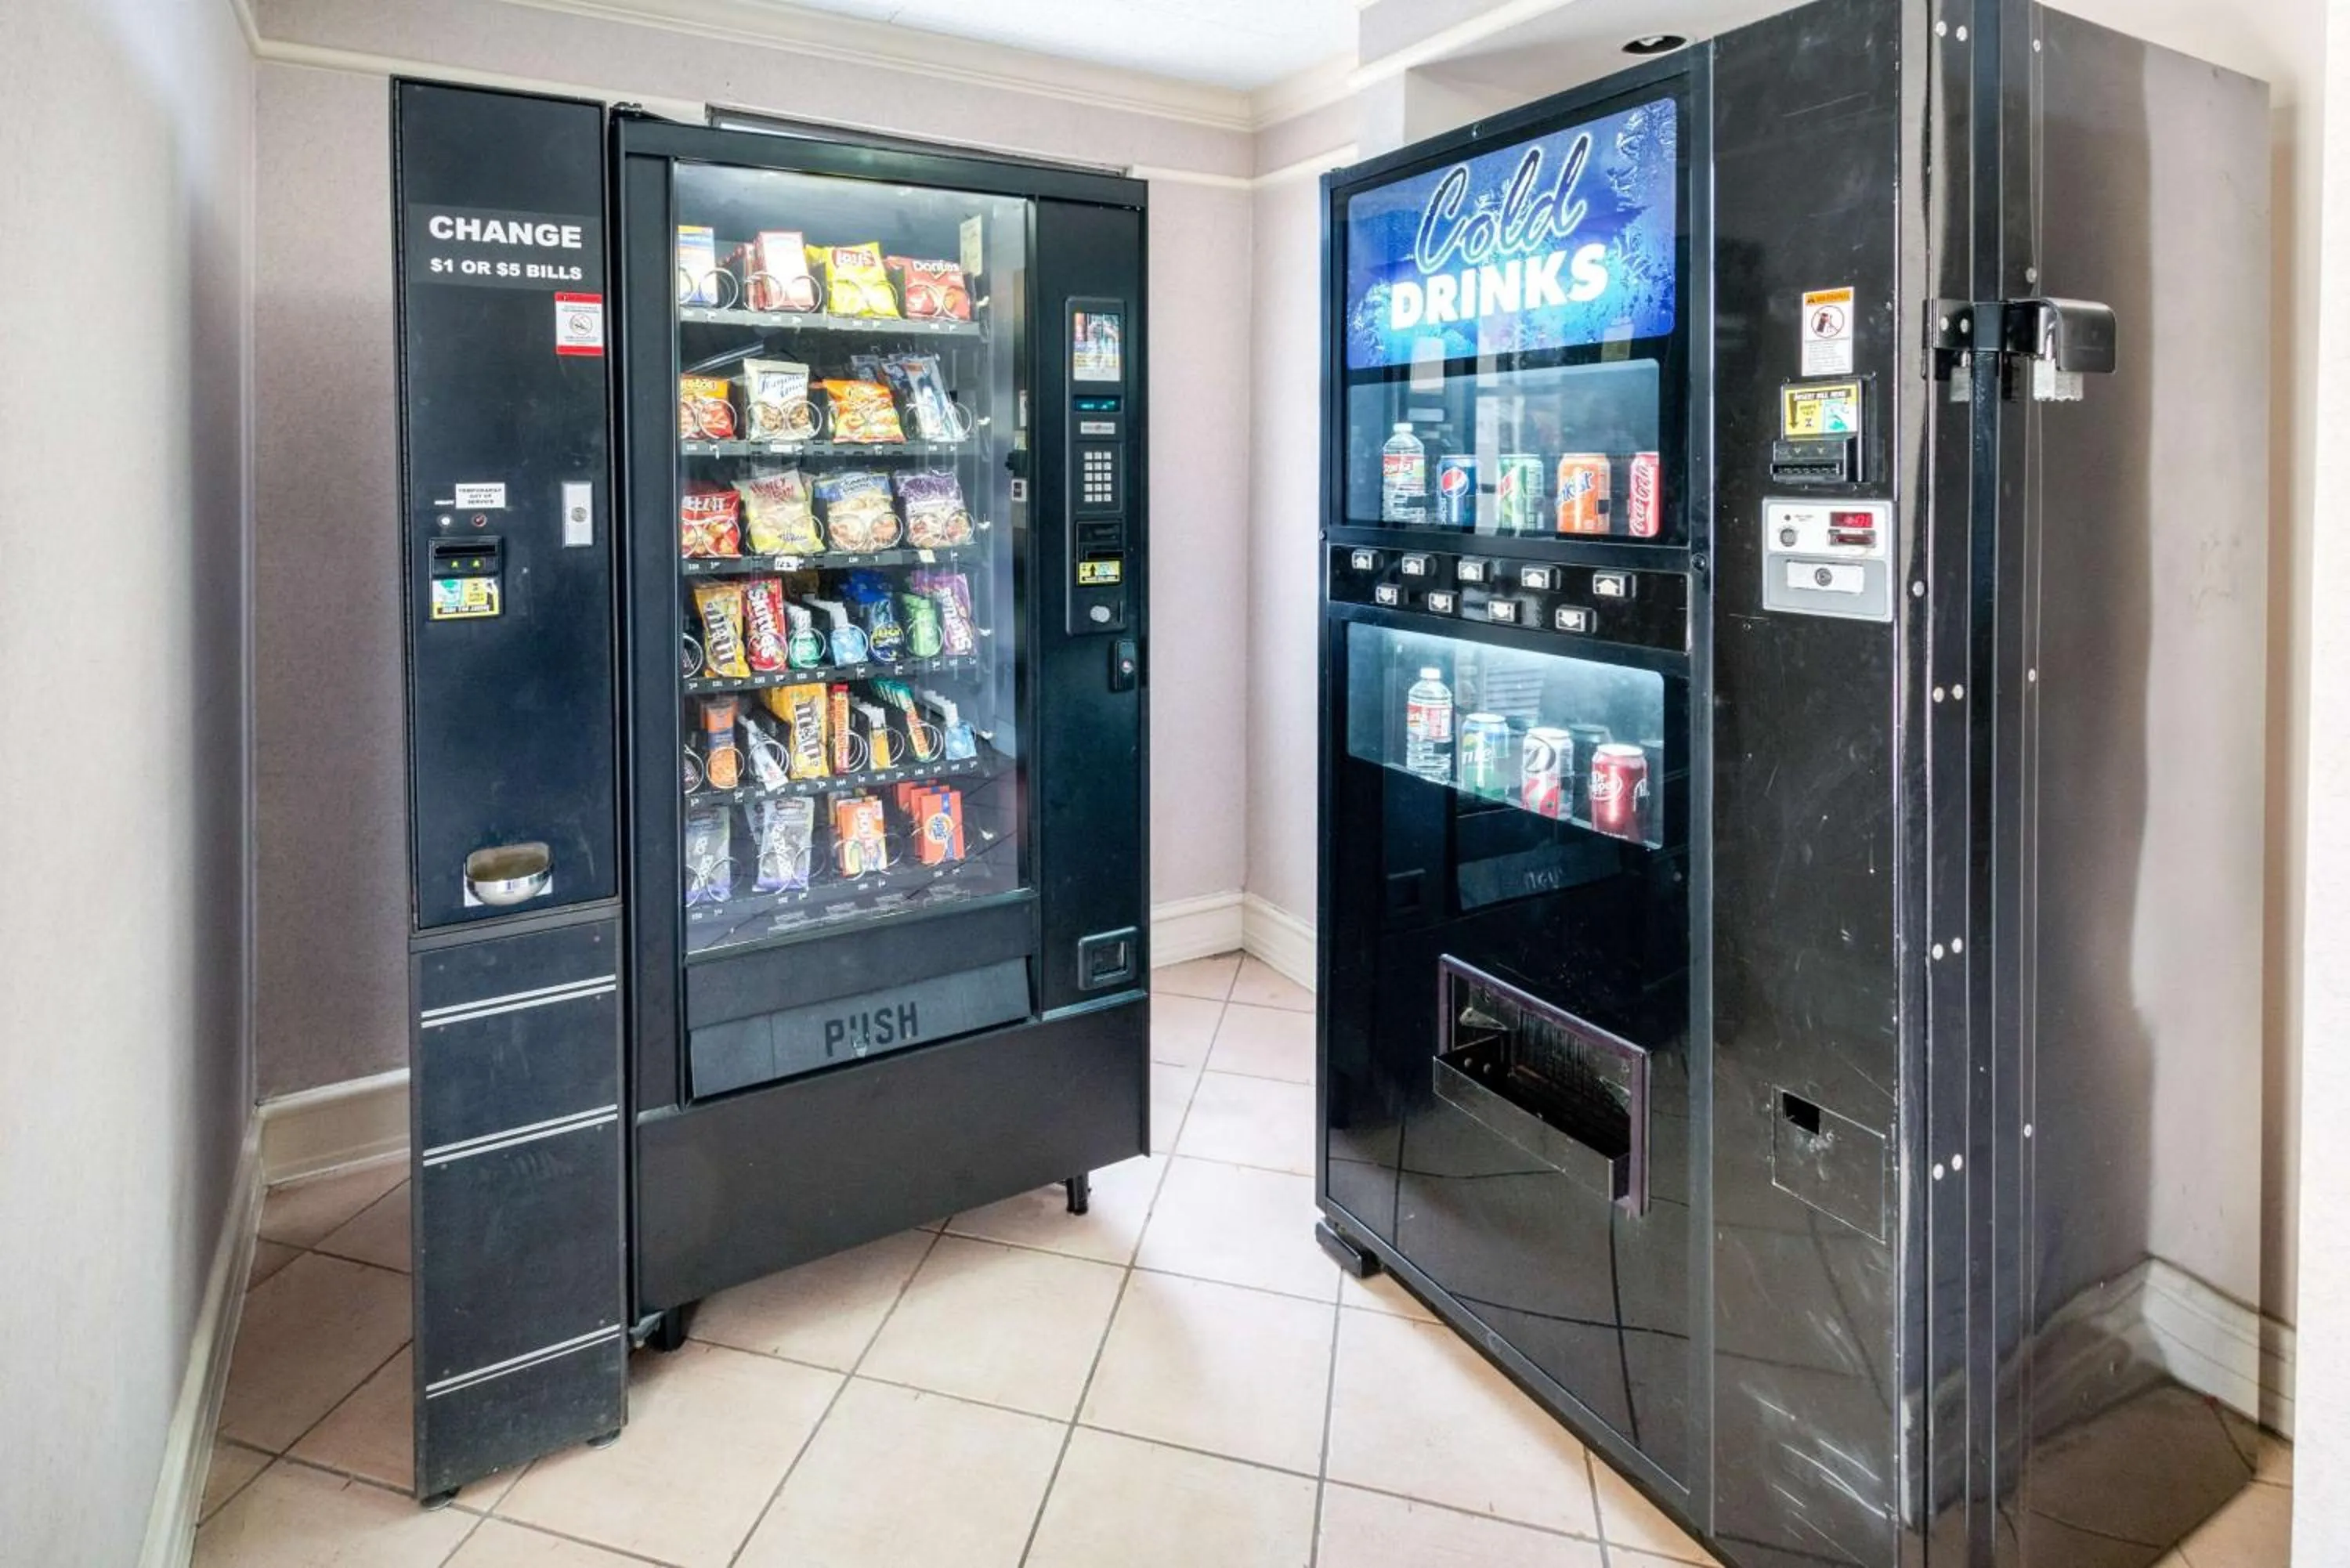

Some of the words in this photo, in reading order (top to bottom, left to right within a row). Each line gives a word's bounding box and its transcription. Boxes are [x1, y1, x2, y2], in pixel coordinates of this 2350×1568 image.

[1415, 132, 1592, 273] Cold
[429, 215, 582, 248] CHANGE
[430, 258, 454, 273] $1
[461, 259, 491, 275] OR
[497, 262, 521, 276] $5
[526, 264, 583, 280] BILLS
[1390, 244, 1609, 331] DRINKS
[825, 1002, 919, 1057] PUSH
